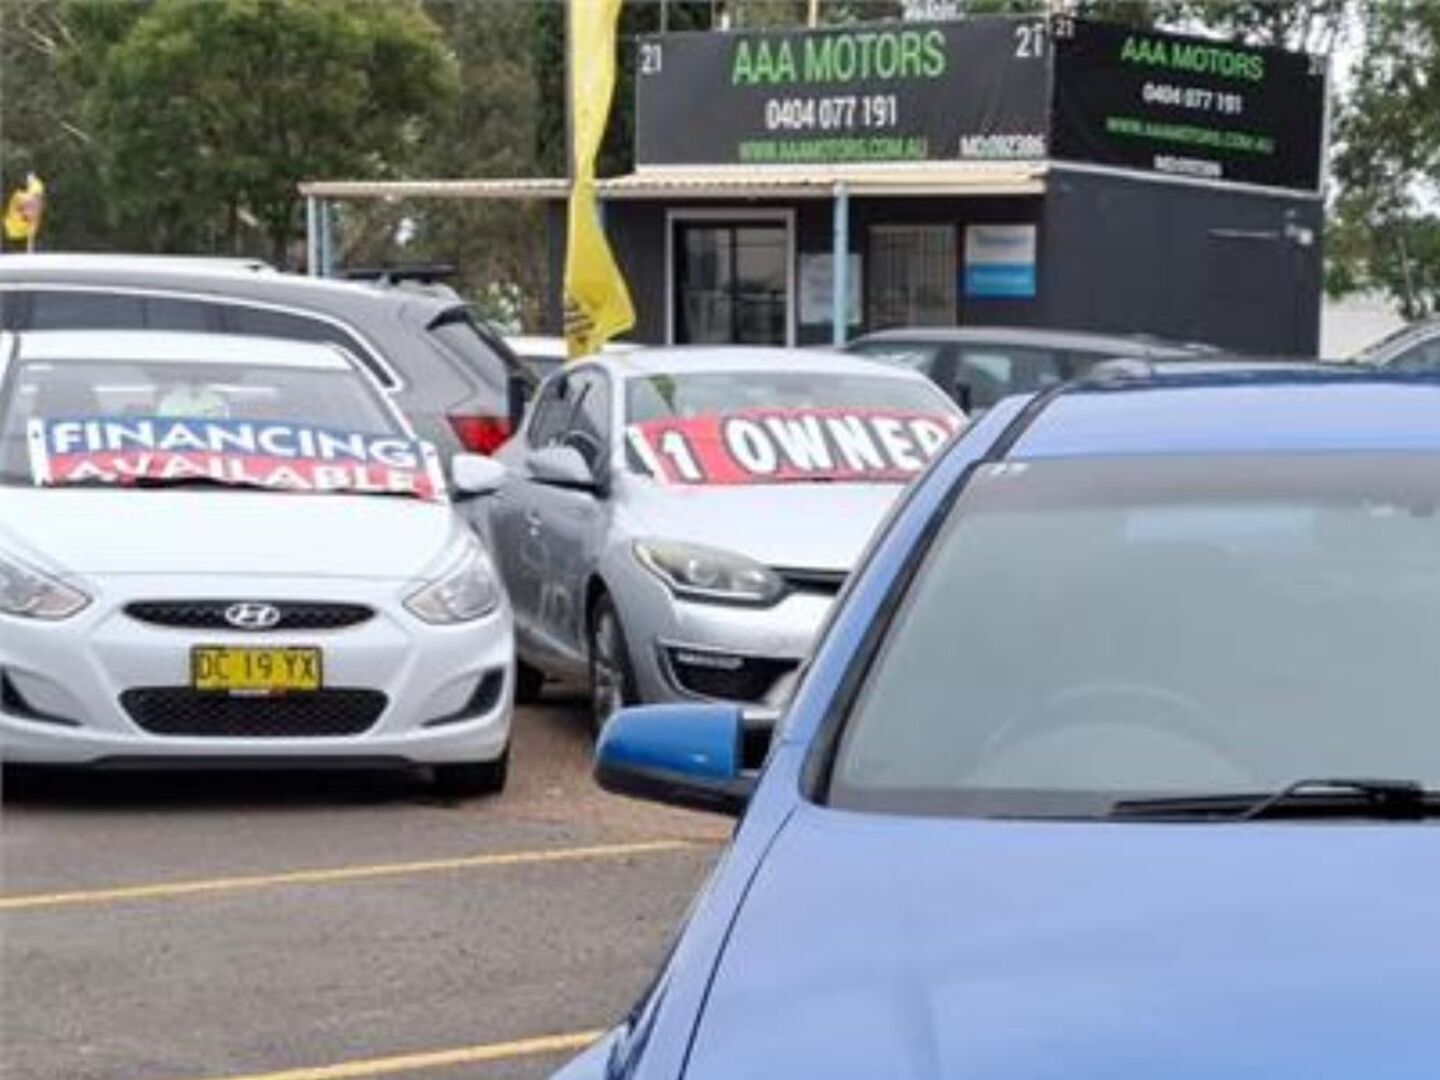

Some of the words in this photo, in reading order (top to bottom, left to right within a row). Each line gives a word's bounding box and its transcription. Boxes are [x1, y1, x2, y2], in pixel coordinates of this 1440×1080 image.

[732, 40, 797, 86] AAA
[805, 30, 946, 83] MOTORS
[1015, 24, 1043, 58] 21
[641, 44, 662, 74] 21
[1121, 37, 1168, 66] AAA
[1171, 43, 1265, 81] MOTORS
[765, 98, 816, 129] 0404
[818, 97, 857, 128] 077
[862, 95, 897, 126] 191
[52, 421, 416, 468] FINANCING
[661, 431, 703, 479] 1
[725, 414, 950, 474] OWNER
[69, 456, 416, 491] AVAILABLE
[244, 653, 273, 680] 19
[283, 653, 316, 680] YX
